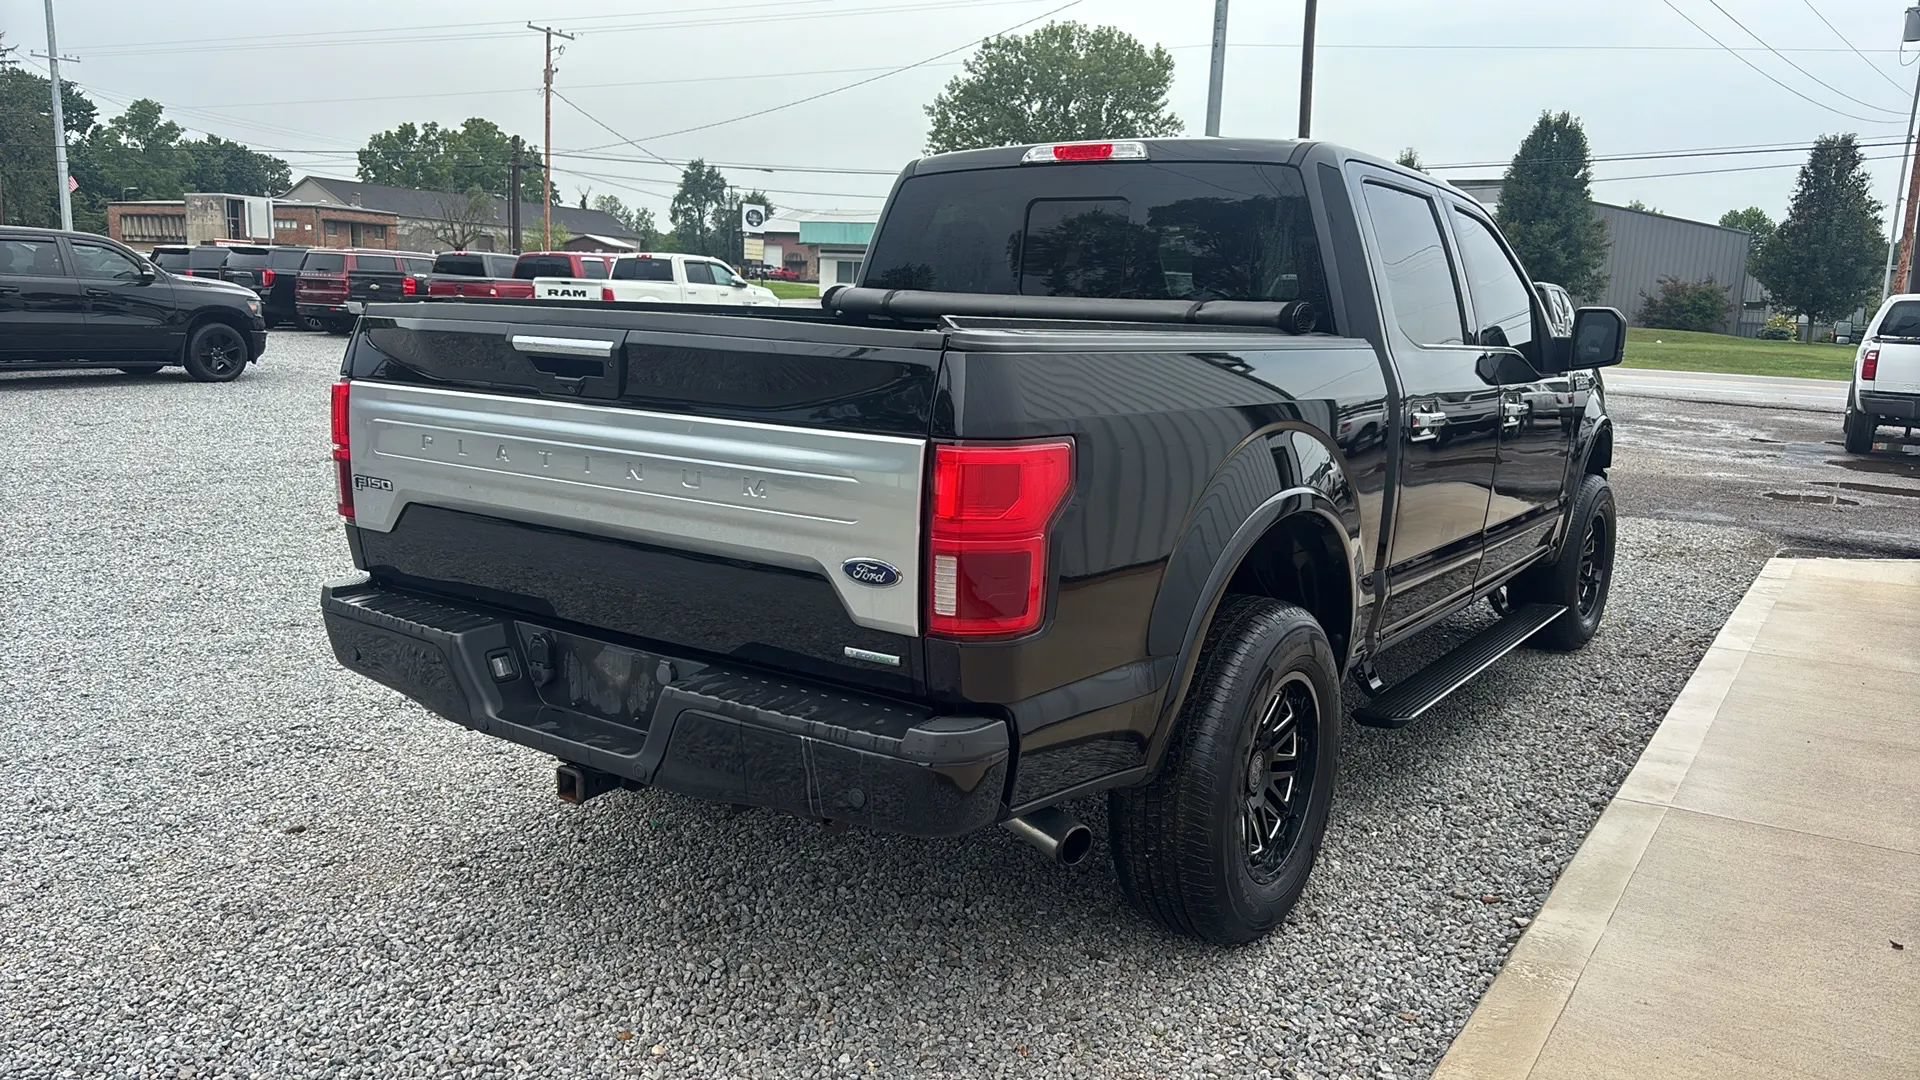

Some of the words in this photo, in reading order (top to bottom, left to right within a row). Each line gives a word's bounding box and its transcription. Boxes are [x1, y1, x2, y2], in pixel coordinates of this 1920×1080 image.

[547, 289, 587, 298] RAM
[421, 434, 767, 498] PLATINUM
[853, 563, 886, 583] Ford
